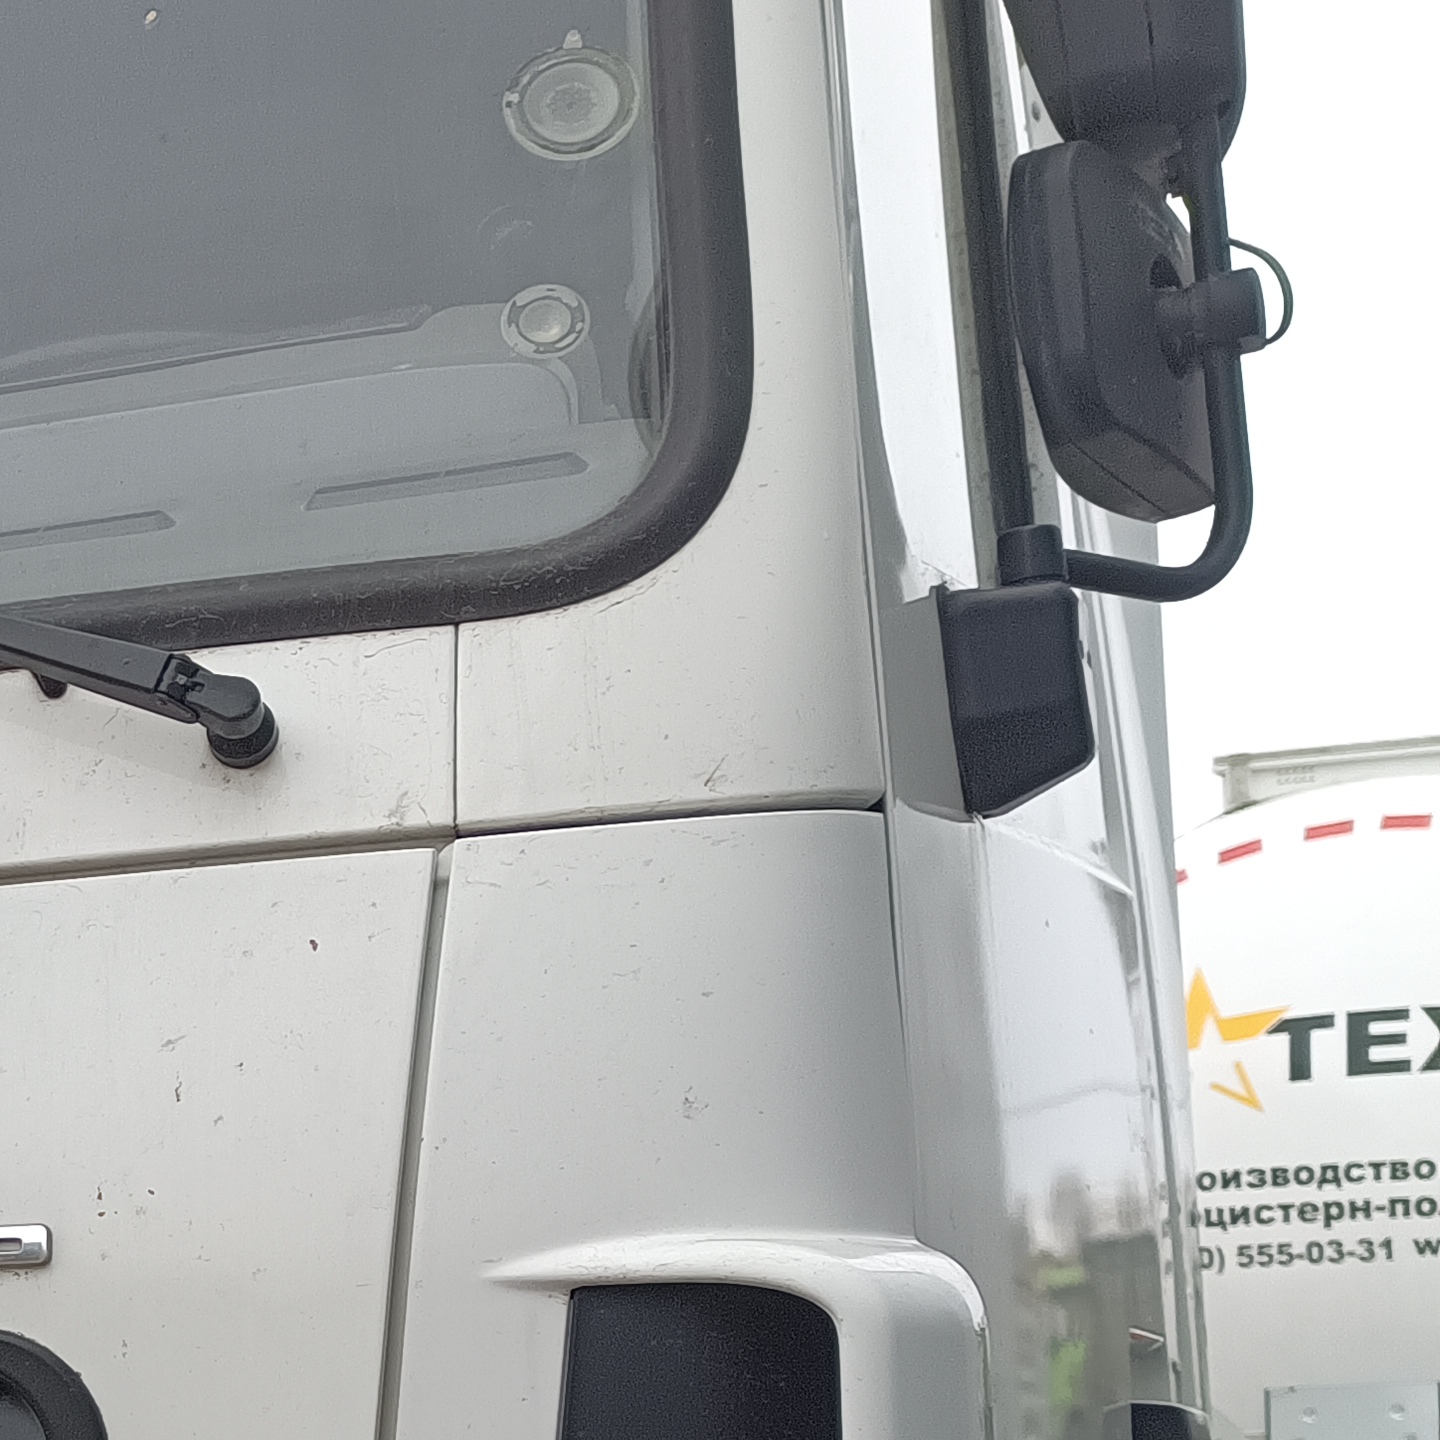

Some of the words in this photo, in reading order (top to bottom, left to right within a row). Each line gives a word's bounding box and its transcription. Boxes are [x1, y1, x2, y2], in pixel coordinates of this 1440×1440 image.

[1196, 1158, 1437, 1191] оизводство
[1190, 1196, 1440, 1231] цистерн-по
[1237, 1237, 1393, 1268] 555-03-31
